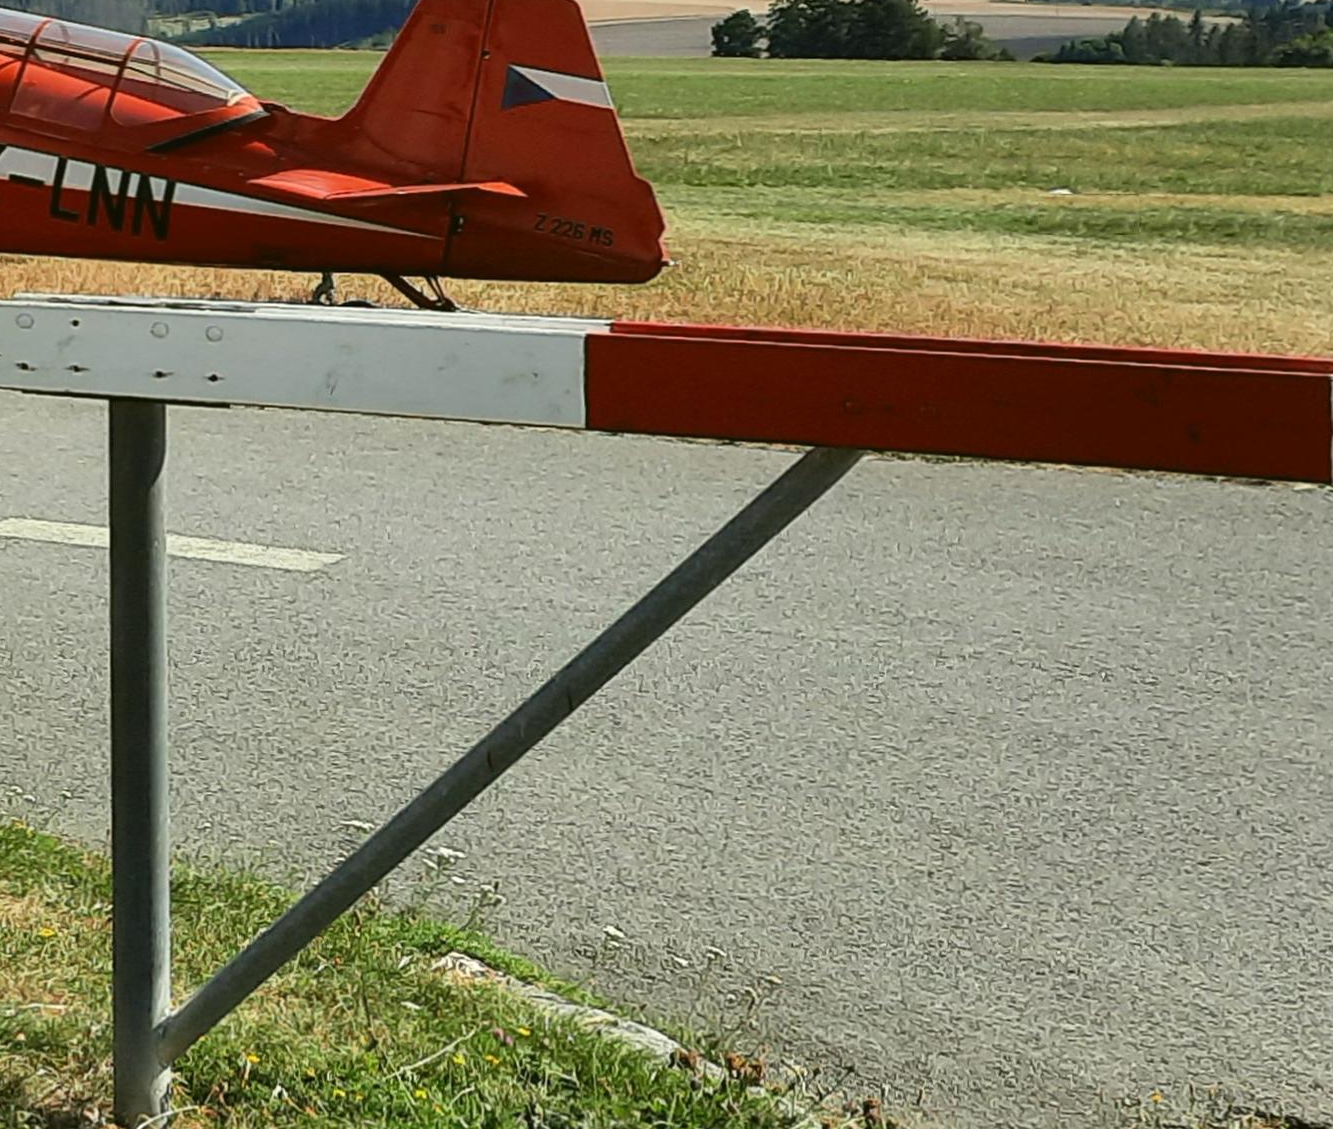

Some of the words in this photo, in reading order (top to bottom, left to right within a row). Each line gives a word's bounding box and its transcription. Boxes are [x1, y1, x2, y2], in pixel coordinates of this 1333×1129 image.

[534, 214, 548, 231] Z
[550, 218, 585, 240] 226
[589, 226, 613, 246] MS
